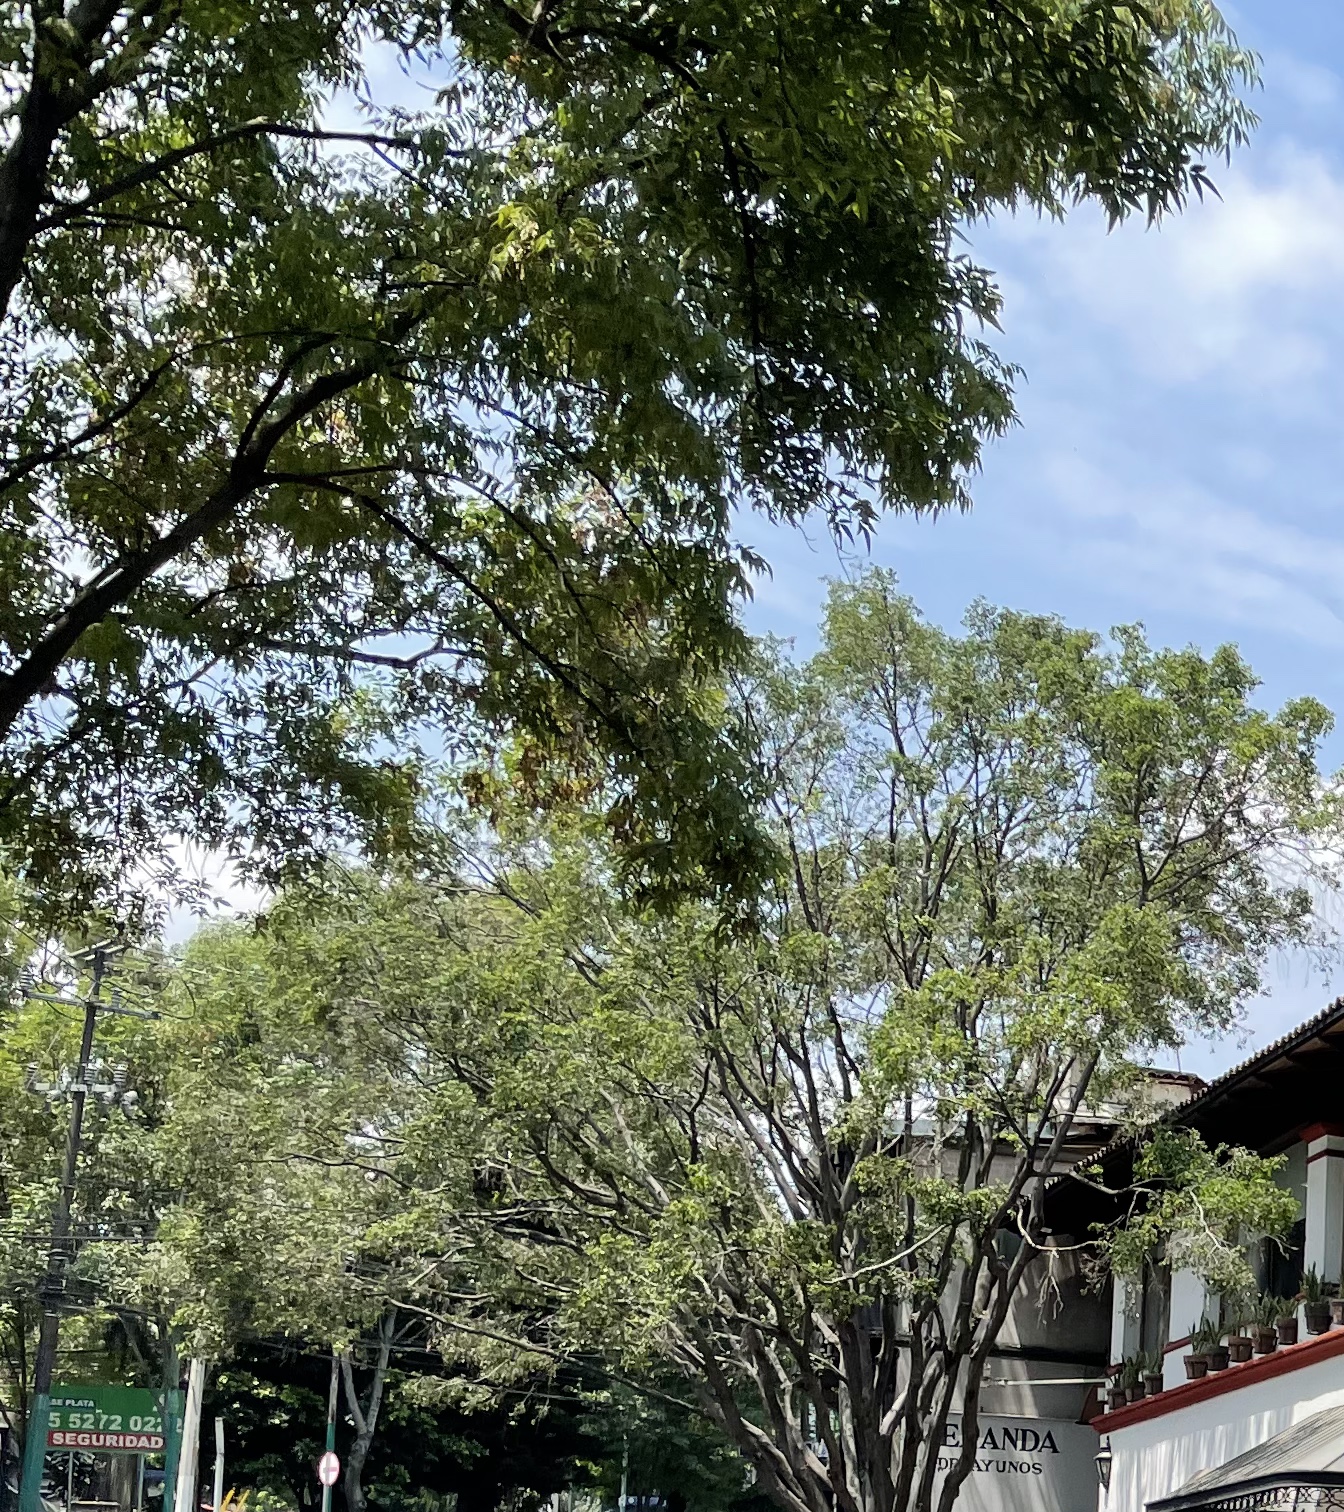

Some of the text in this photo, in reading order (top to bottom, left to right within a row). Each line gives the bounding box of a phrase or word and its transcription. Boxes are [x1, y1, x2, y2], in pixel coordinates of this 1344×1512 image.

[65, 1399, 95, 1407] PLATA
[68, 1413, 122, 1431] 5272
[52, 1432, 164, 1449] SEGURIDAD
[939, 1423, 1061, 1454] EANDA
